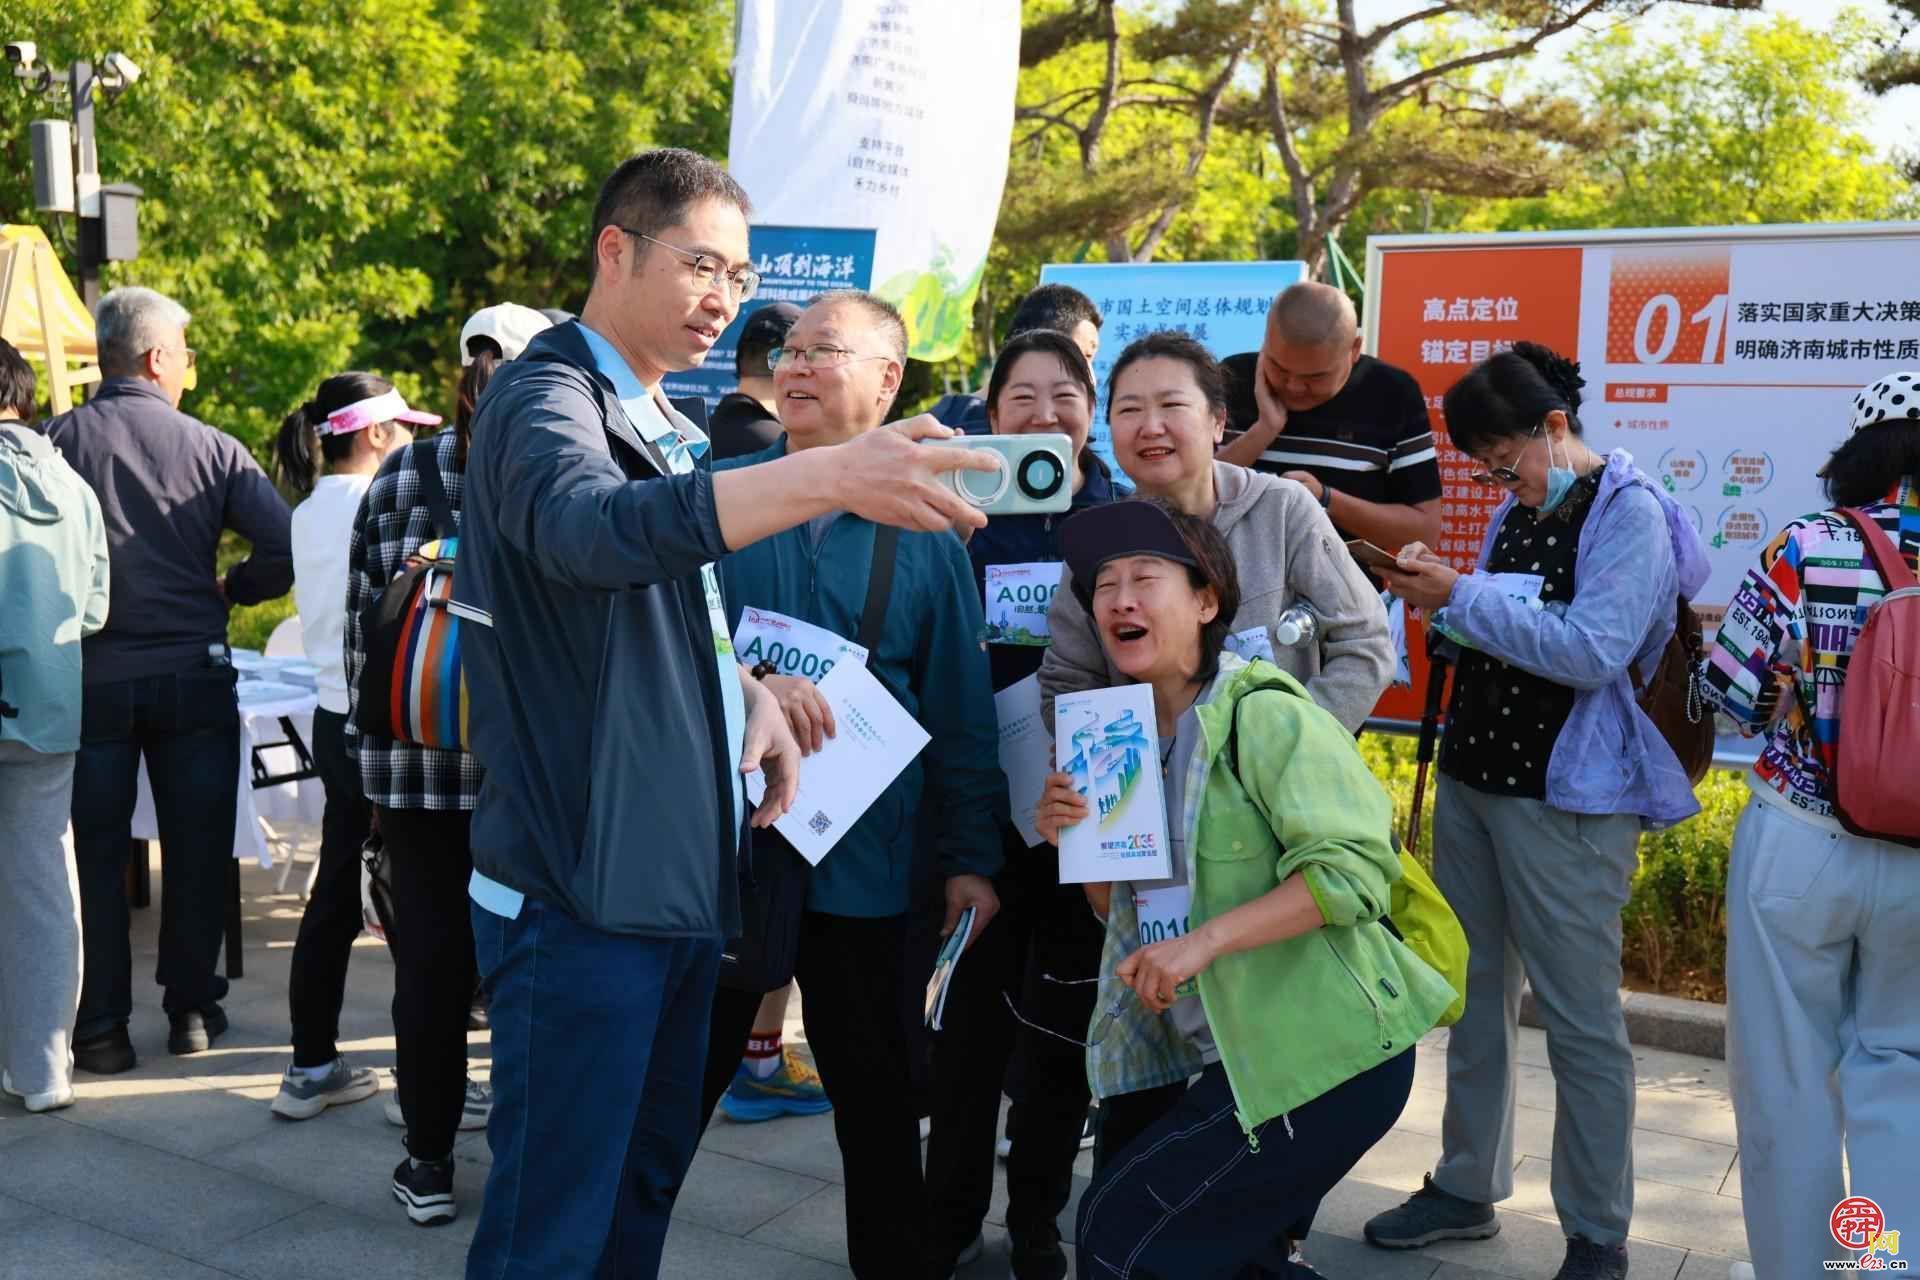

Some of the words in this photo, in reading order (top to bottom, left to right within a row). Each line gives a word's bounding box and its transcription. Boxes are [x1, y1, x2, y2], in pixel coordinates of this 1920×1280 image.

[1423, 296, 1519, 323] 高点定位
[1737, 301, 1920, 323] 落实国家重大决策
[1633, 293, 1729, 364] 01
[1735, 339, 1920, 361] 明确济南城市性质
